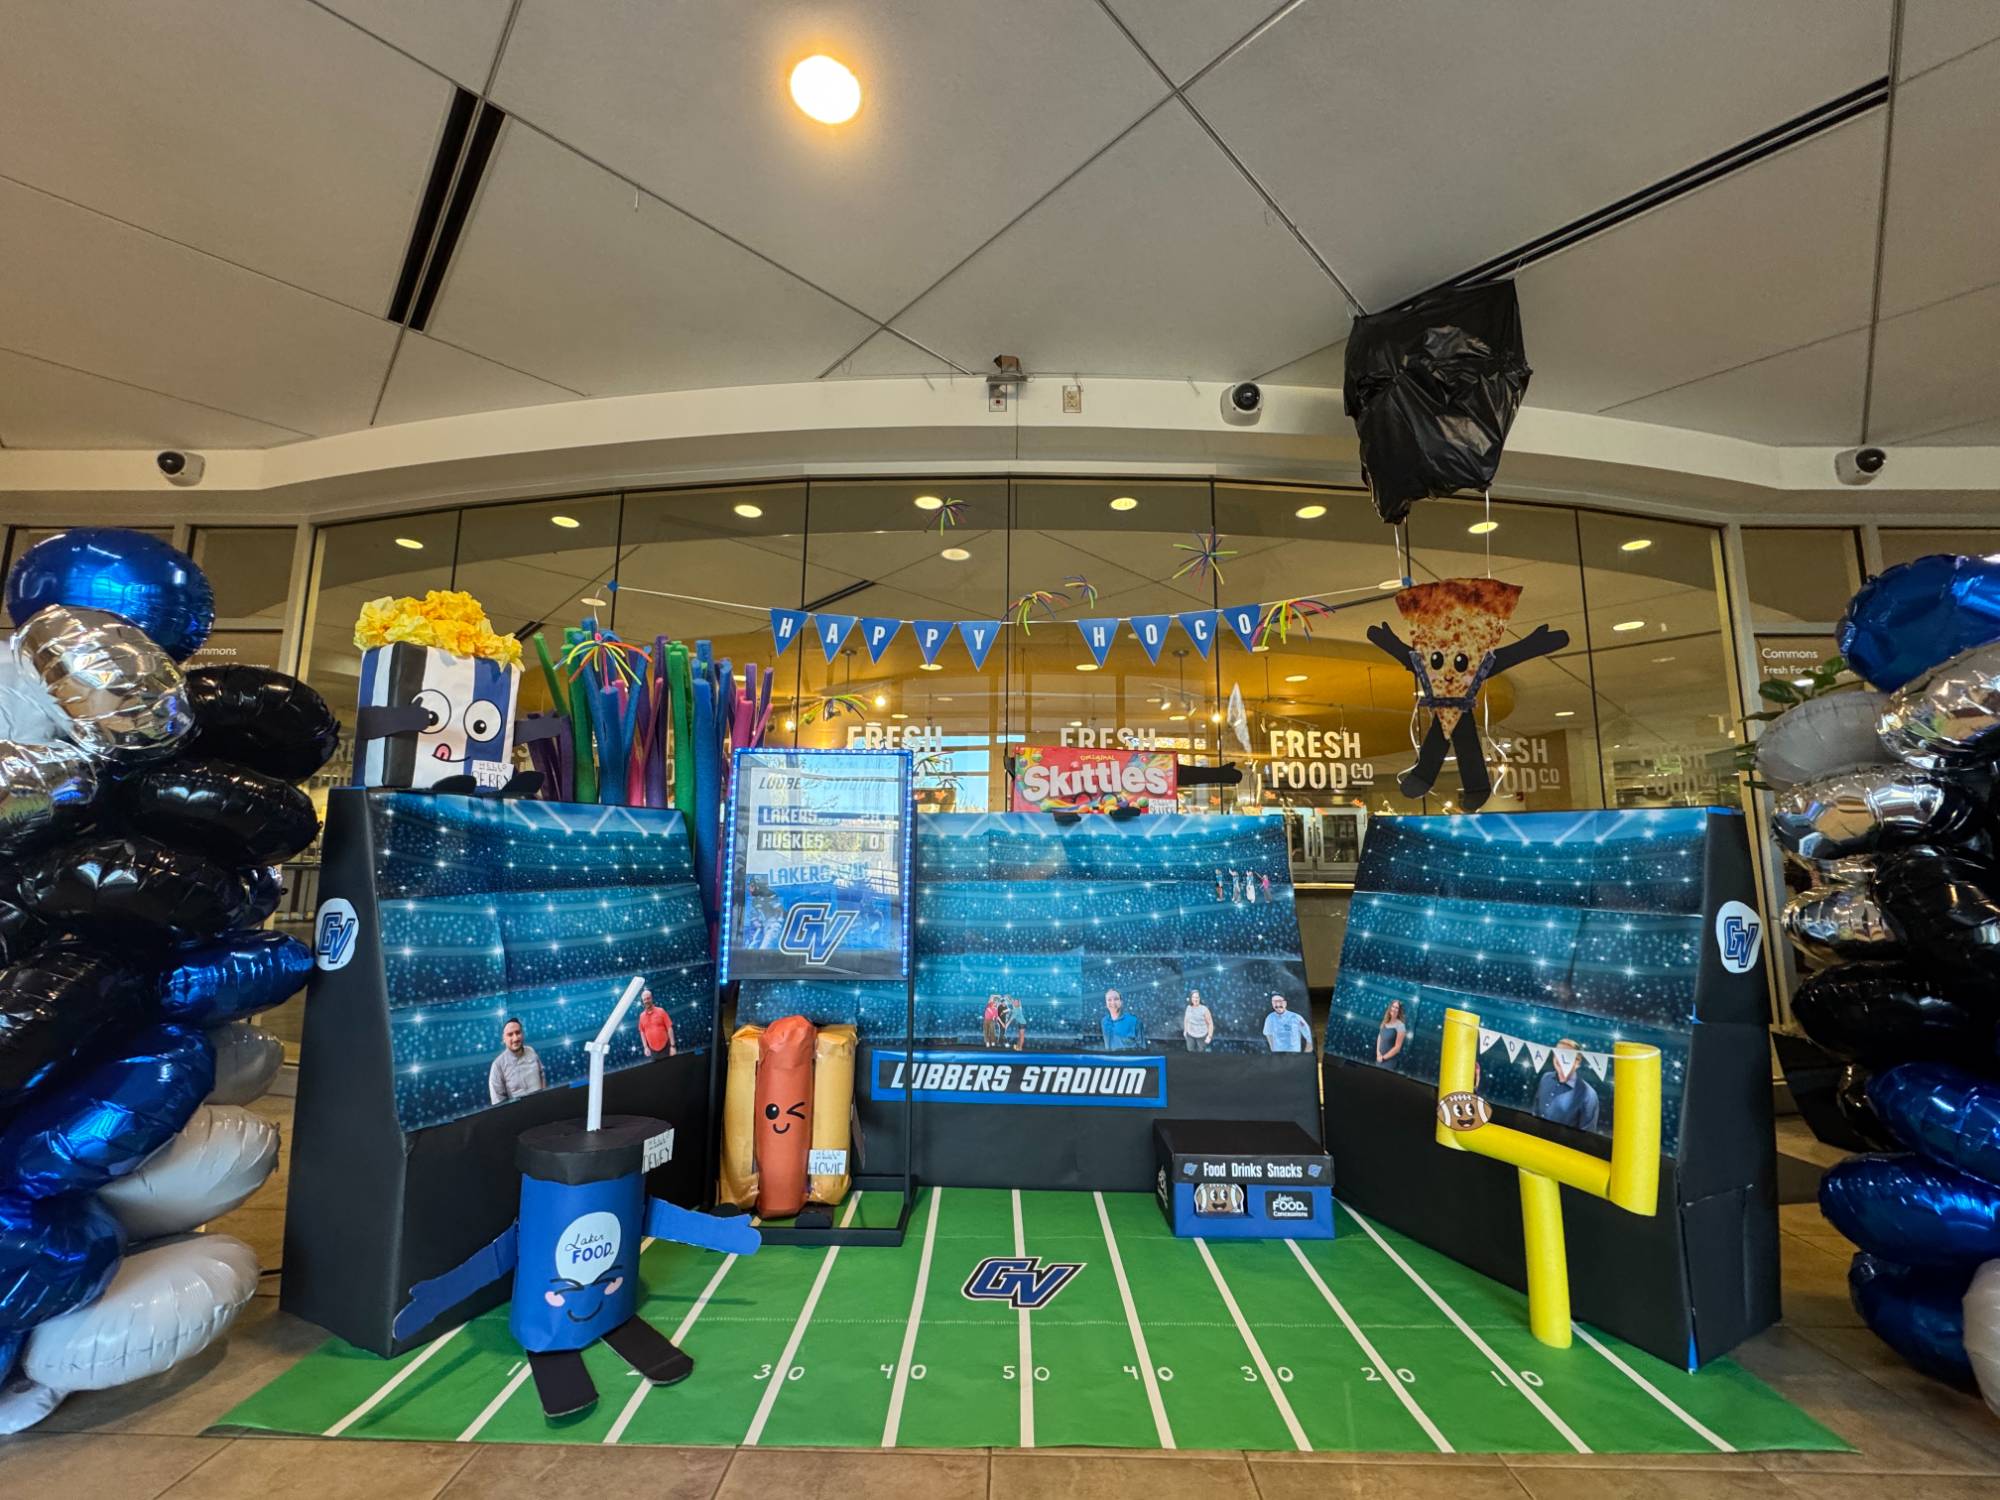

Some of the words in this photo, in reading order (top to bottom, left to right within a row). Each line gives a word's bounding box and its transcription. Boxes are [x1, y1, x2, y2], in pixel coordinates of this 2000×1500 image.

[779, 618, 985, 650] HAPPY
[1093, 613, 1252, 648] HOCO
[1762, 648, 1818, 659] Commons
[1763, 665, 1788, 674] Fresh
[847, 726, 942, 752] FRESH
[1060, 727, 1156, 751] FRESH
[1270, 729, 1361, 758] FRESH
[1482, 737, 1548, 764] RESH
[479, 763, 508, 772] HELLO
[1272, 761, 1348, 789] FOOD
[1350, 763, 1374, 779] CO
[1540, 767, 1560, 784] CO
[1024, 761, 1169, 802] Skittles
[762, 808, 818, 824] LAKERS
[761, 832, 825, 849] HUSKIES
[869, 834, 880, 849] 0
[319, 912, 356, 964] GV
[780, 903, 860, 965] GV
[1724, 916, 1759, 968] GV
[891, 1062, 1012, 1092] LUBBERS
[1019, 1066, 1147, 1095] STADIUM
[1203, 1162, 1226, 1177] Food
[1231, 1162, 1262, 1178] Drinks
[1267, 1162, 1303, 1178] Snacks
[1273, 1201, 1304, 1211] FOOD
[565, 1233, 605, 1252] Laker
[572, 1242, 613, 1264] FOOD
[961, 1257, 1087, 1310] GV
